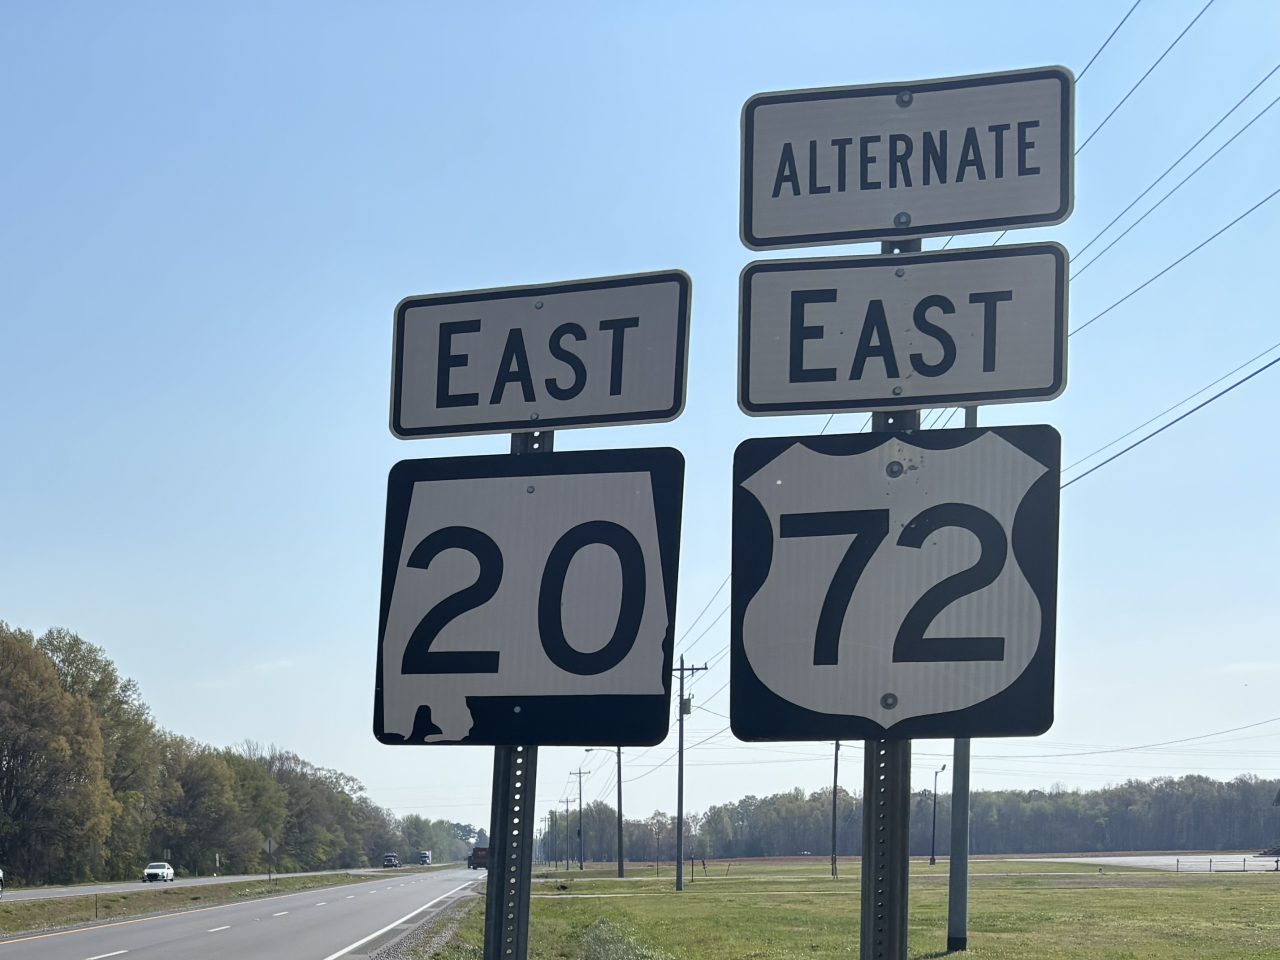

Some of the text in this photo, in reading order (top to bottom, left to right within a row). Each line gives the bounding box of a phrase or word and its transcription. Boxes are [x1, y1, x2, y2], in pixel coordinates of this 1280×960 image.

[772, 120, 1041, 198] ALTERNATE
[436, 317, 639, 408] EAST
[789, 288, 1012, 383] EAST
[401, 520, 646, 675] 20
[779, 502, 1008, 666] 72
